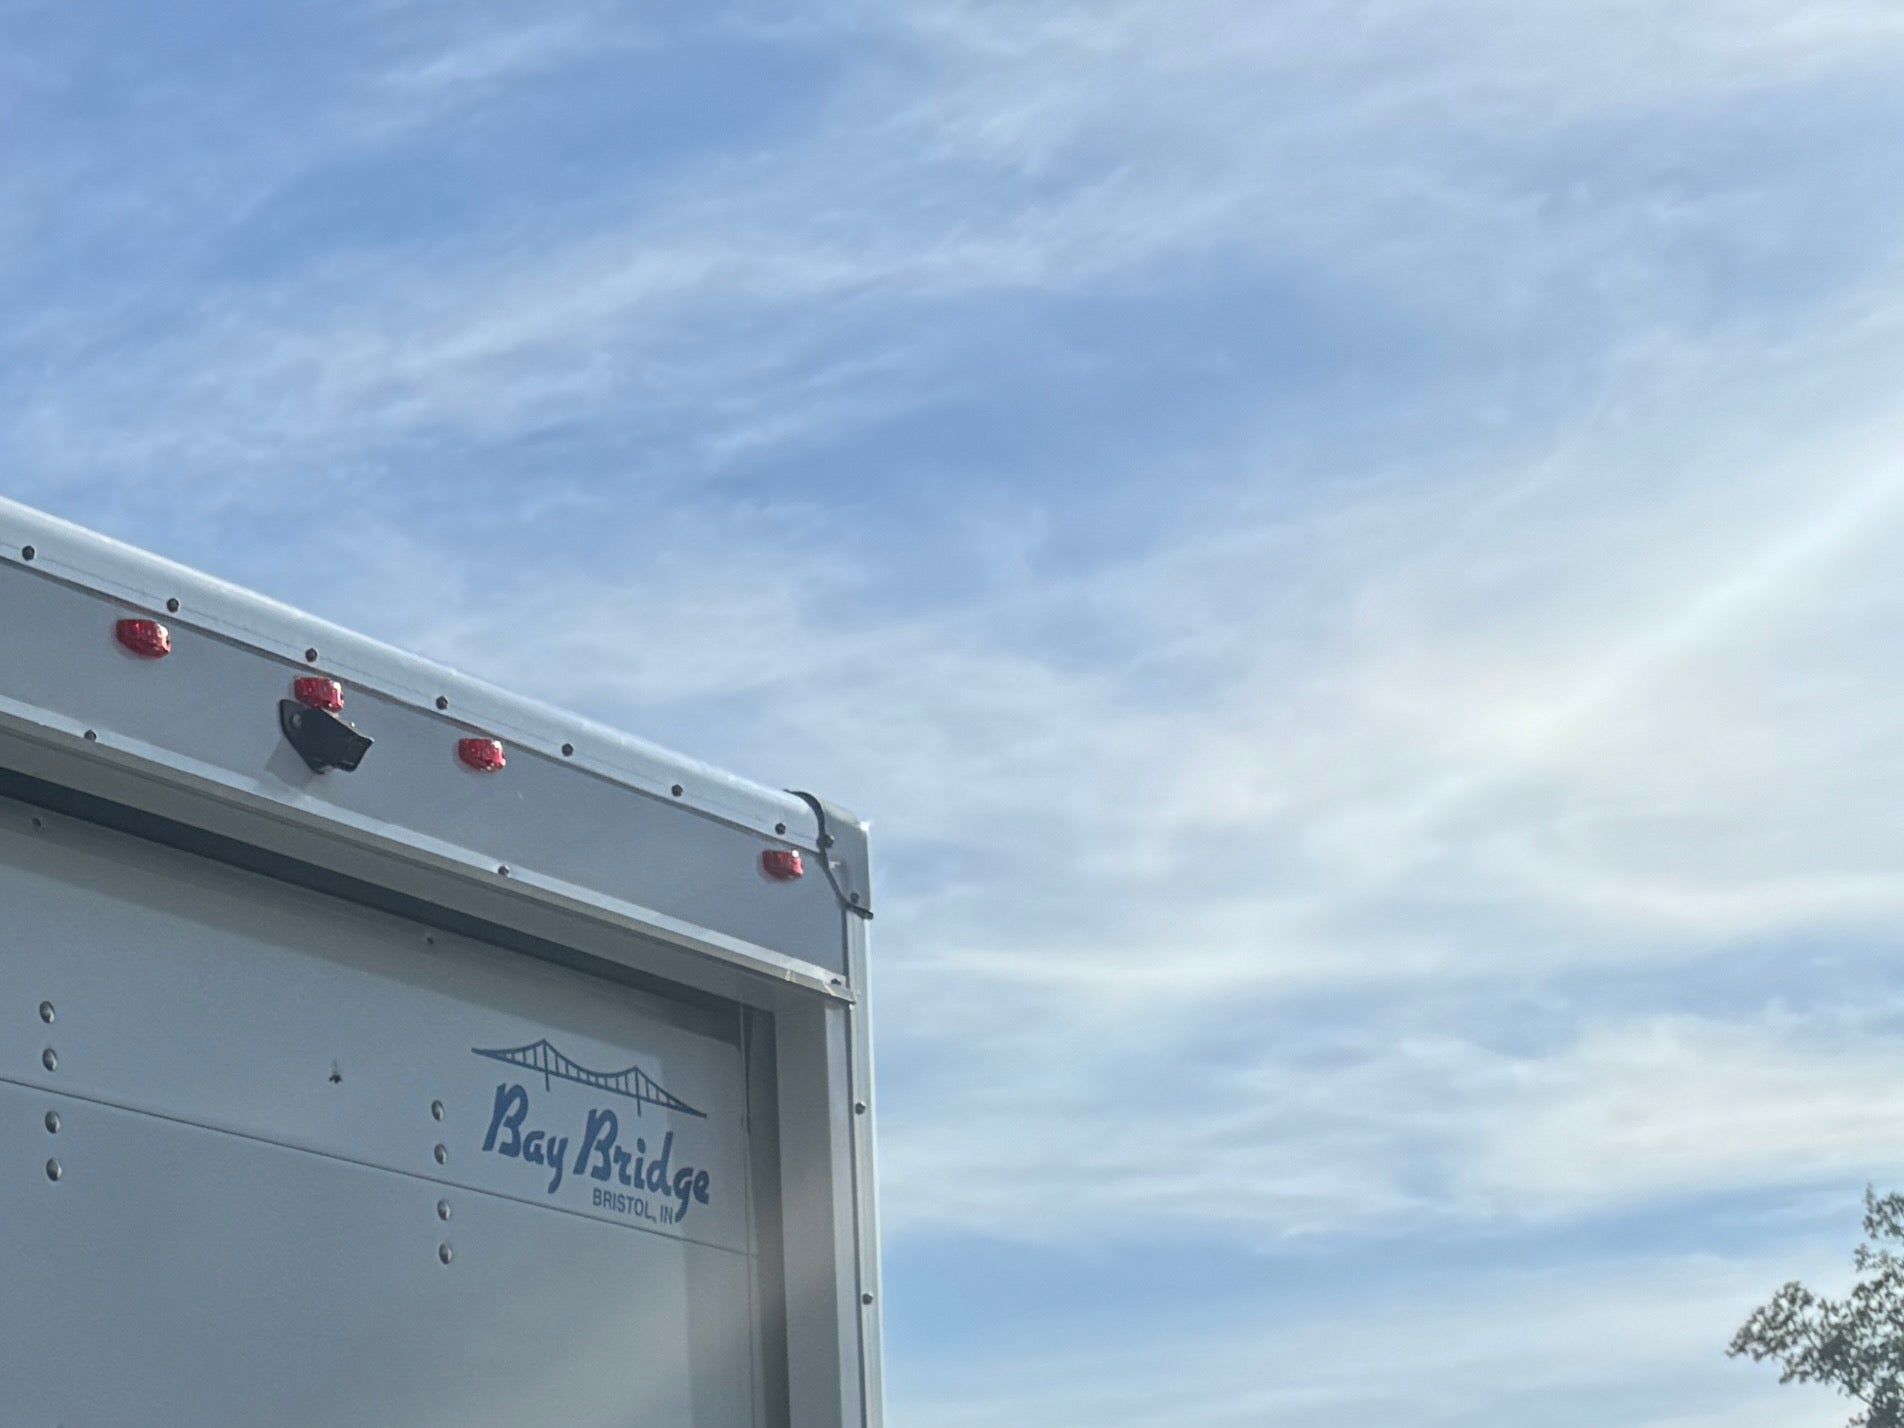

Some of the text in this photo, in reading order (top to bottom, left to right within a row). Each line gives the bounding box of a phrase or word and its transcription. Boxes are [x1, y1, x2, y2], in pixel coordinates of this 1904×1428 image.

[482, 1083, 710, 1223] Bay Bridge
[592, 1187, 674, 1225] BRISTOL, IN
